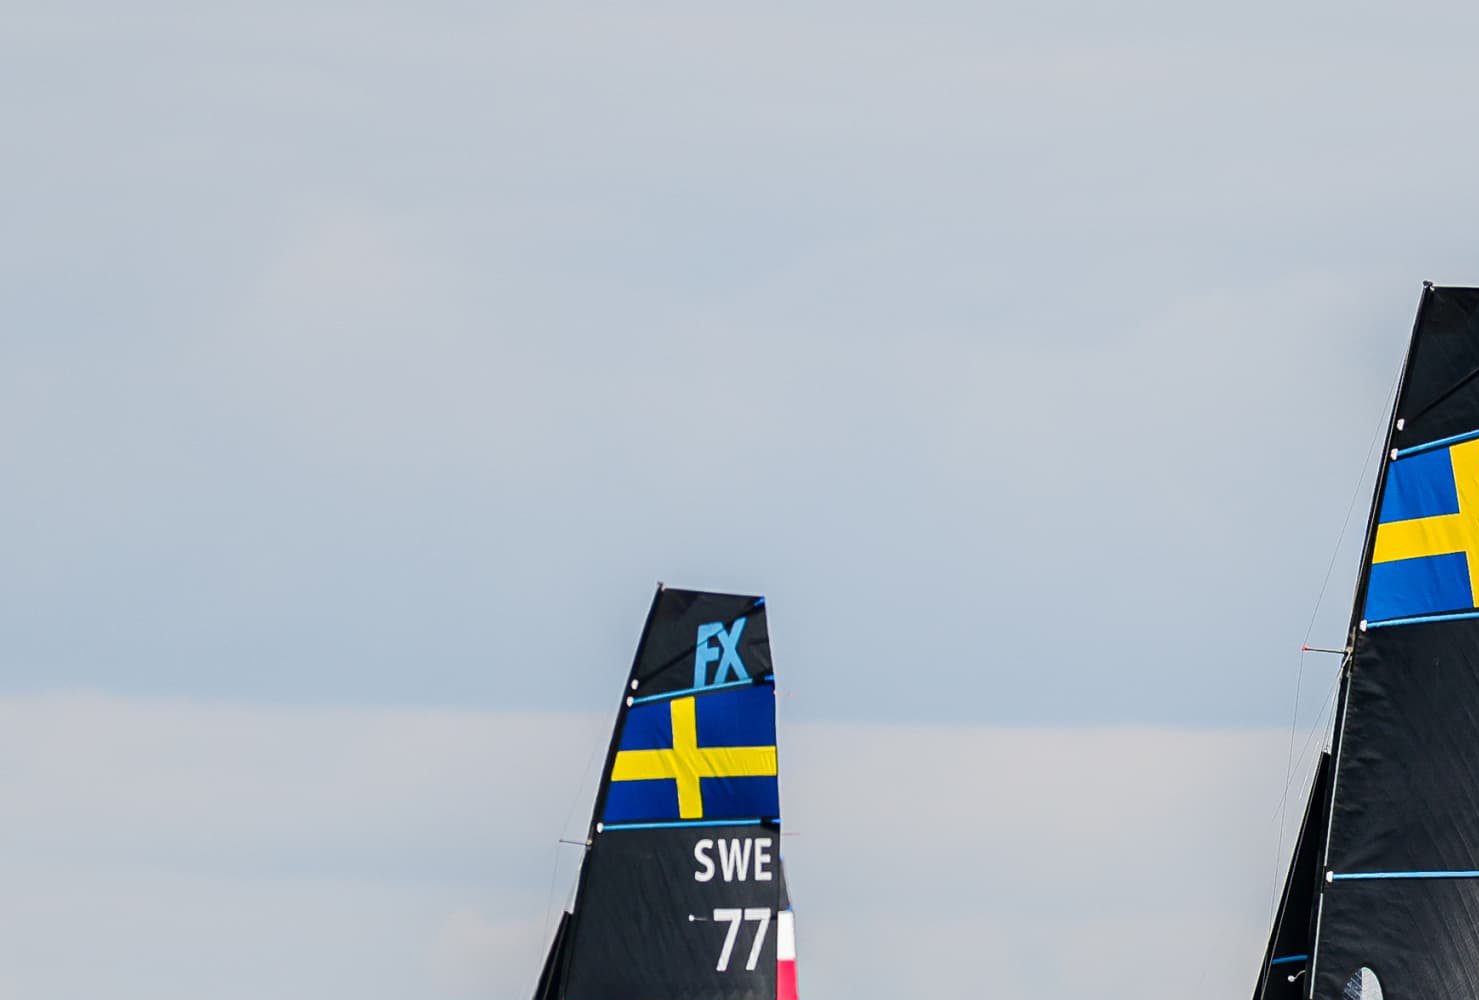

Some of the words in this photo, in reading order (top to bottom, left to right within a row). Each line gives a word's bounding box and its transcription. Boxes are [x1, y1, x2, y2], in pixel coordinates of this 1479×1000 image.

[693, 617, 750, 689] FX
[693, 837, 773, 883] SWE
[712, 907, 772, 972] 77
